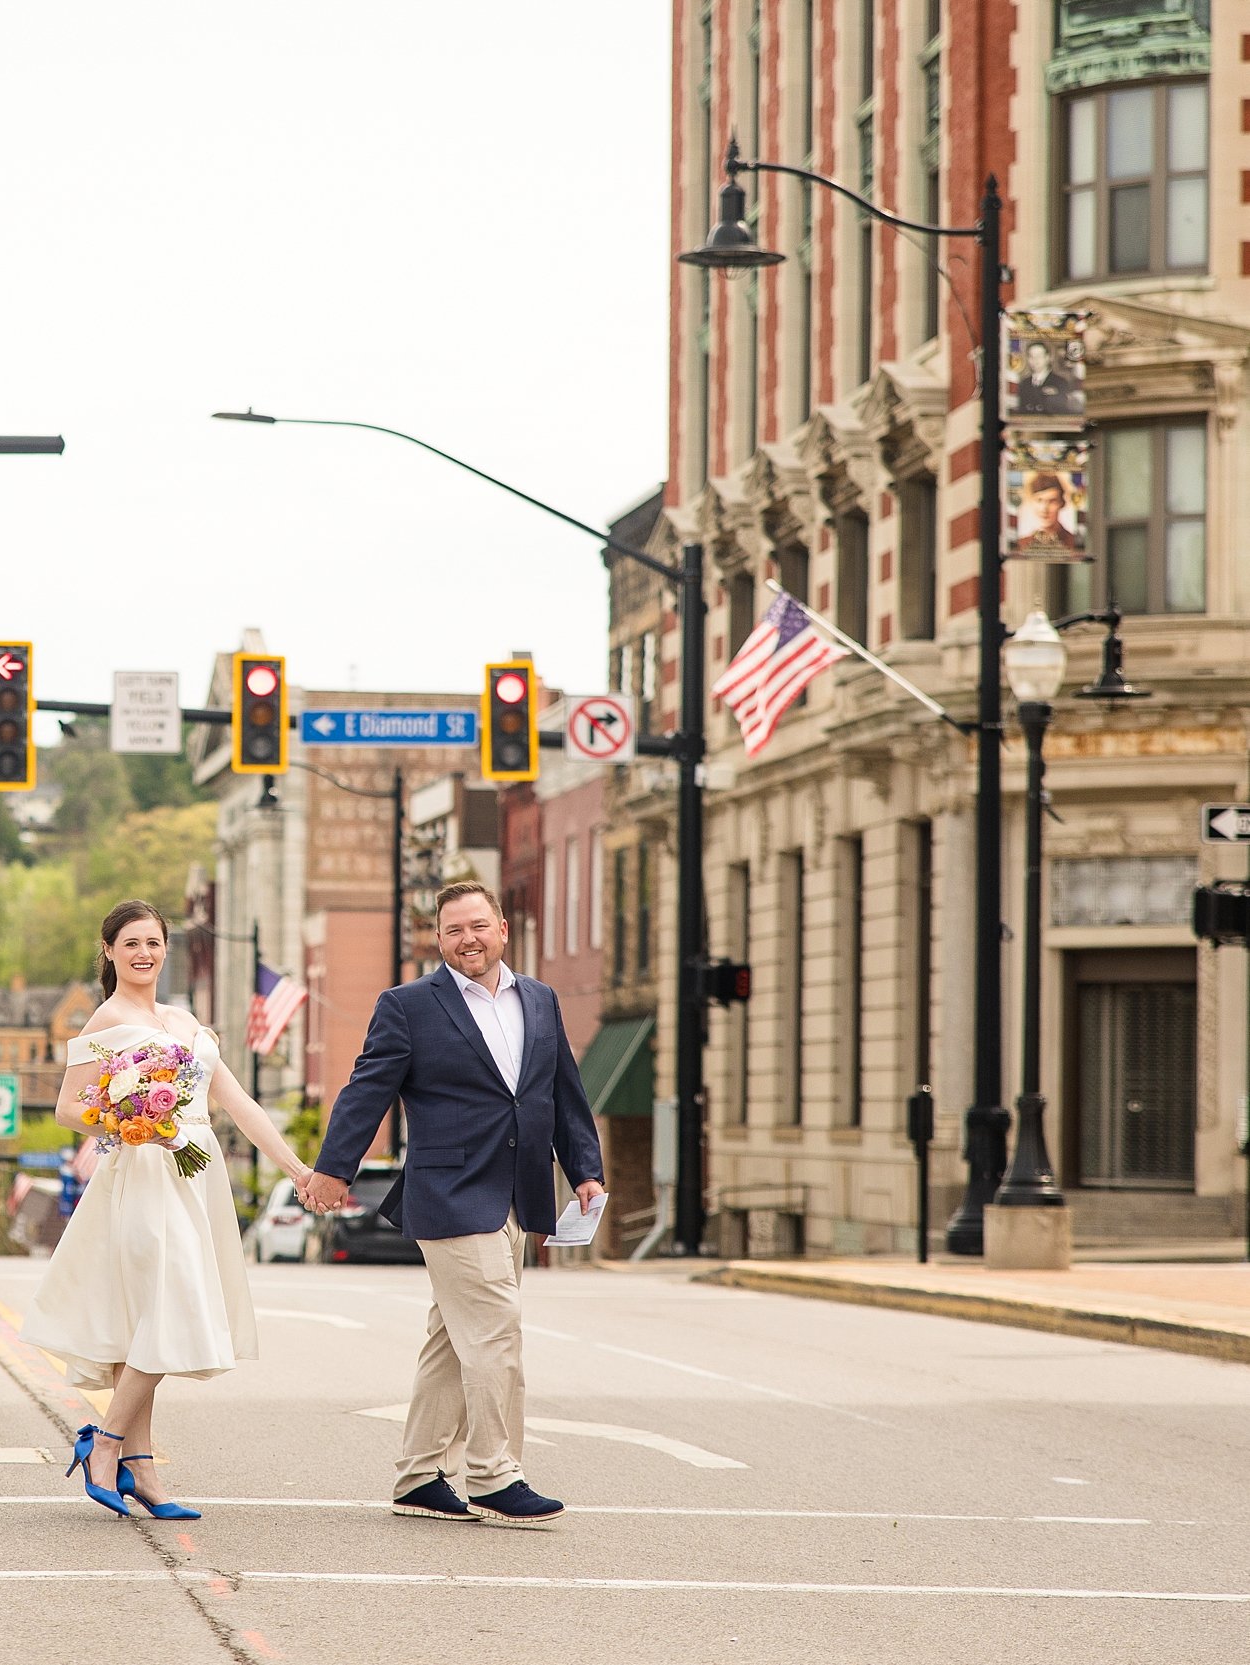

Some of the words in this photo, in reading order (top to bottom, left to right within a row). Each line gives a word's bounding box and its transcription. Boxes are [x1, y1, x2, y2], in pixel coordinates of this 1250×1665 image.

[344, 713, 357, 737] E
[359, 712, 438, 737] Diamond
[445, 713, 466, 738] St
